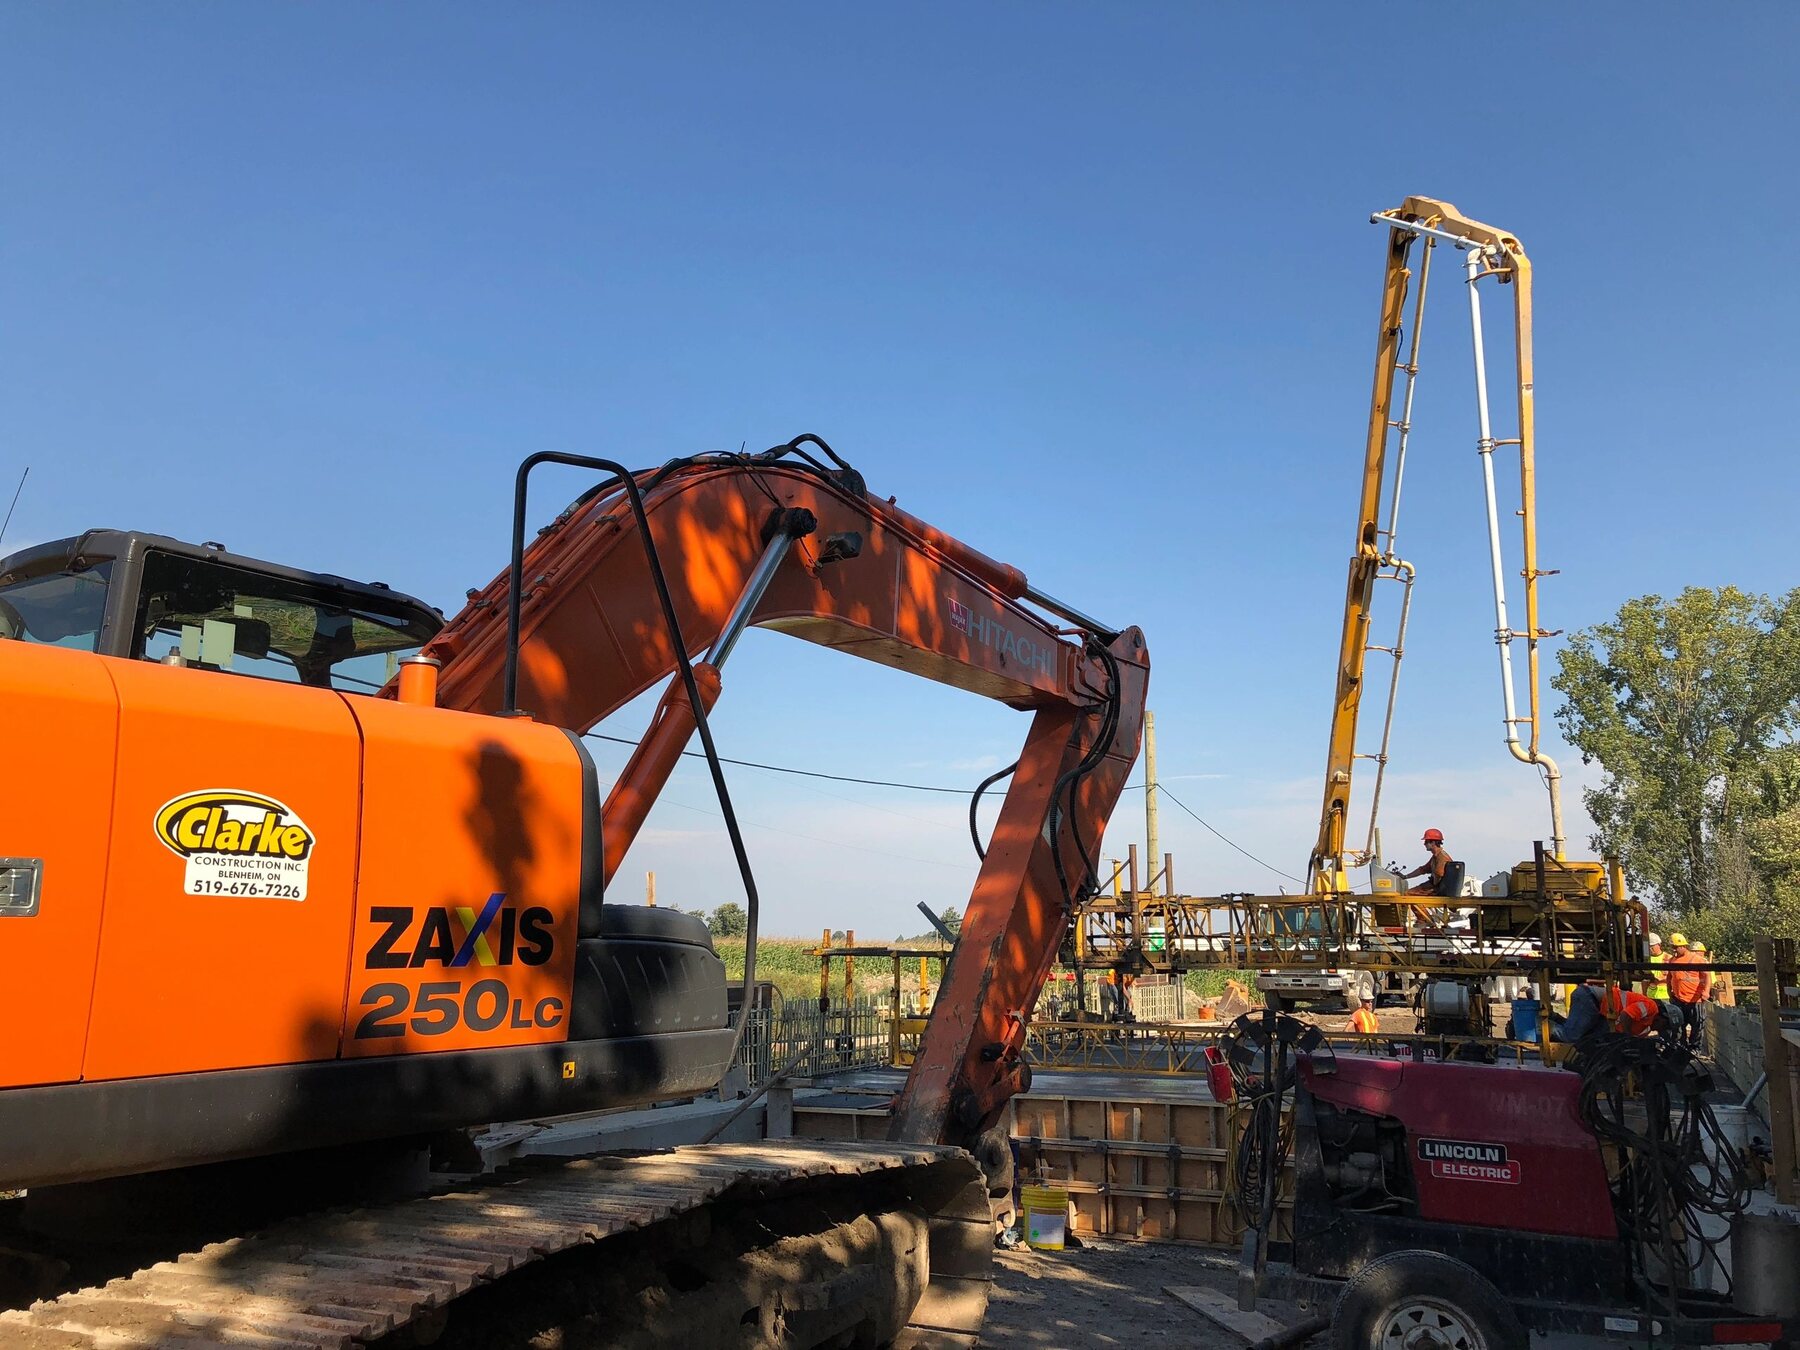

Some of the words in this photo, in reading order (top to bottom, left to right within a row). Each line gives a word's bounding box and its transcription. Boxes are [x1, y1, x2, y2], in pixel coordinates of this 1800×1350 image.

[967, 608, 1052, 677] HITACHI
[177, 806, 309, 858] Clarke
[194, 856, 281, 869] CONSTRUCTION
[284, 862, 304, 872] INC.
[218, 870, 264, 881] BLENHEIM,
[267, 872, 281, 880] ON
[193, 879, 300, 898] 519-676-7226
[365, 892, 554, 969] ZAXIS
[1425, 1143, 1500, 1162] LINCOLN
[1442, 1163, 1512, 1179] ELECTRIC
